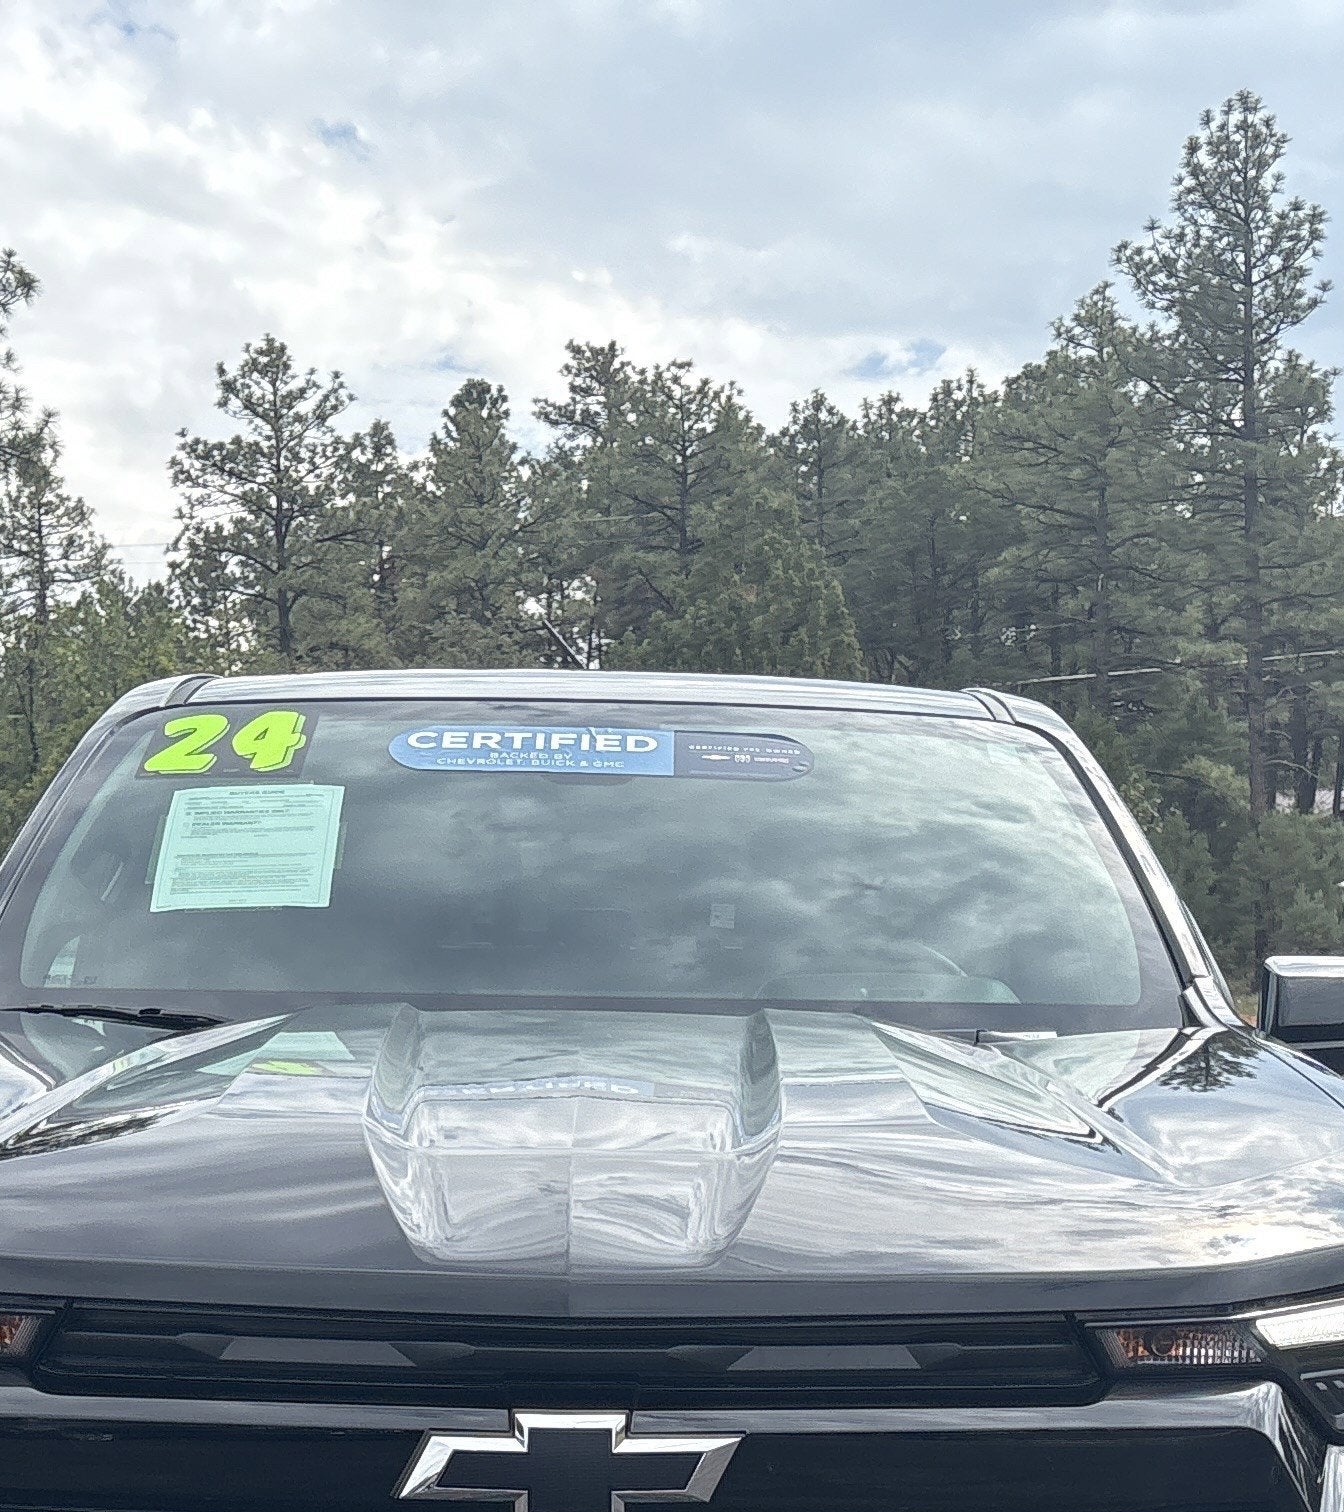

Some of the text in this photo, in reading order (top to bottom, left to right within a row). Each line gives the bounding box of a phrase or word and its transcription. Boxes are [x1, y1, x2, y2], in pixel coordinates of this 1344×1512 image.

[144, 711, 307, 774] 24
[407, 731, 658, 753] CERTIFIED
[489, 752, 549, 760] BACKED
[531, 759, 576, 767] BUICK
[592, 760, 625, 768] GMC
